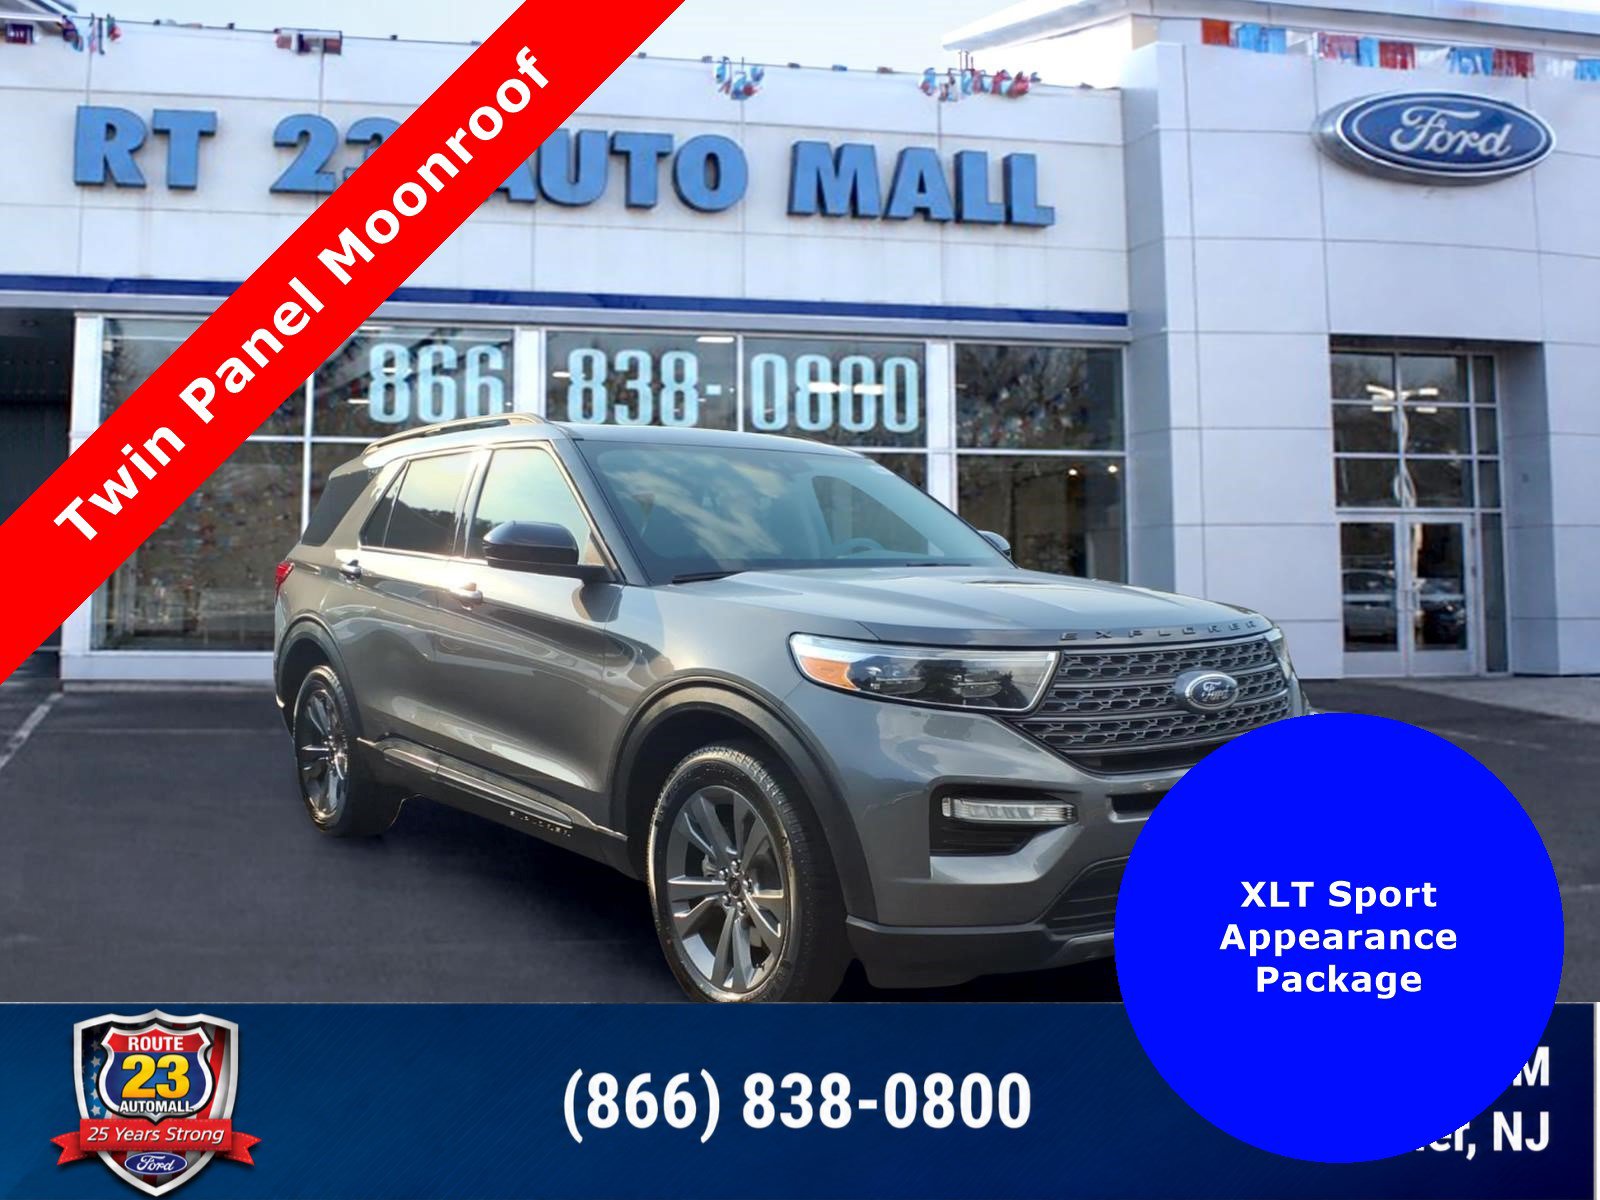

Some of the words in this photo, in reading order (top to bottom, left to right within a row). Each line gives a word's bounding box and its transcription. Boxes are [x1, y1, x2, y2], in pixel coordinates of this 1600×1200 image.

[1390, 105, 1511, 158] Ford
[74, 105, 217, 190] RT
[787, 140, 1056, 228] MALL
[368, 343, 506, 424] 866
[1060, 619, 1258, 641] EXPLORER
